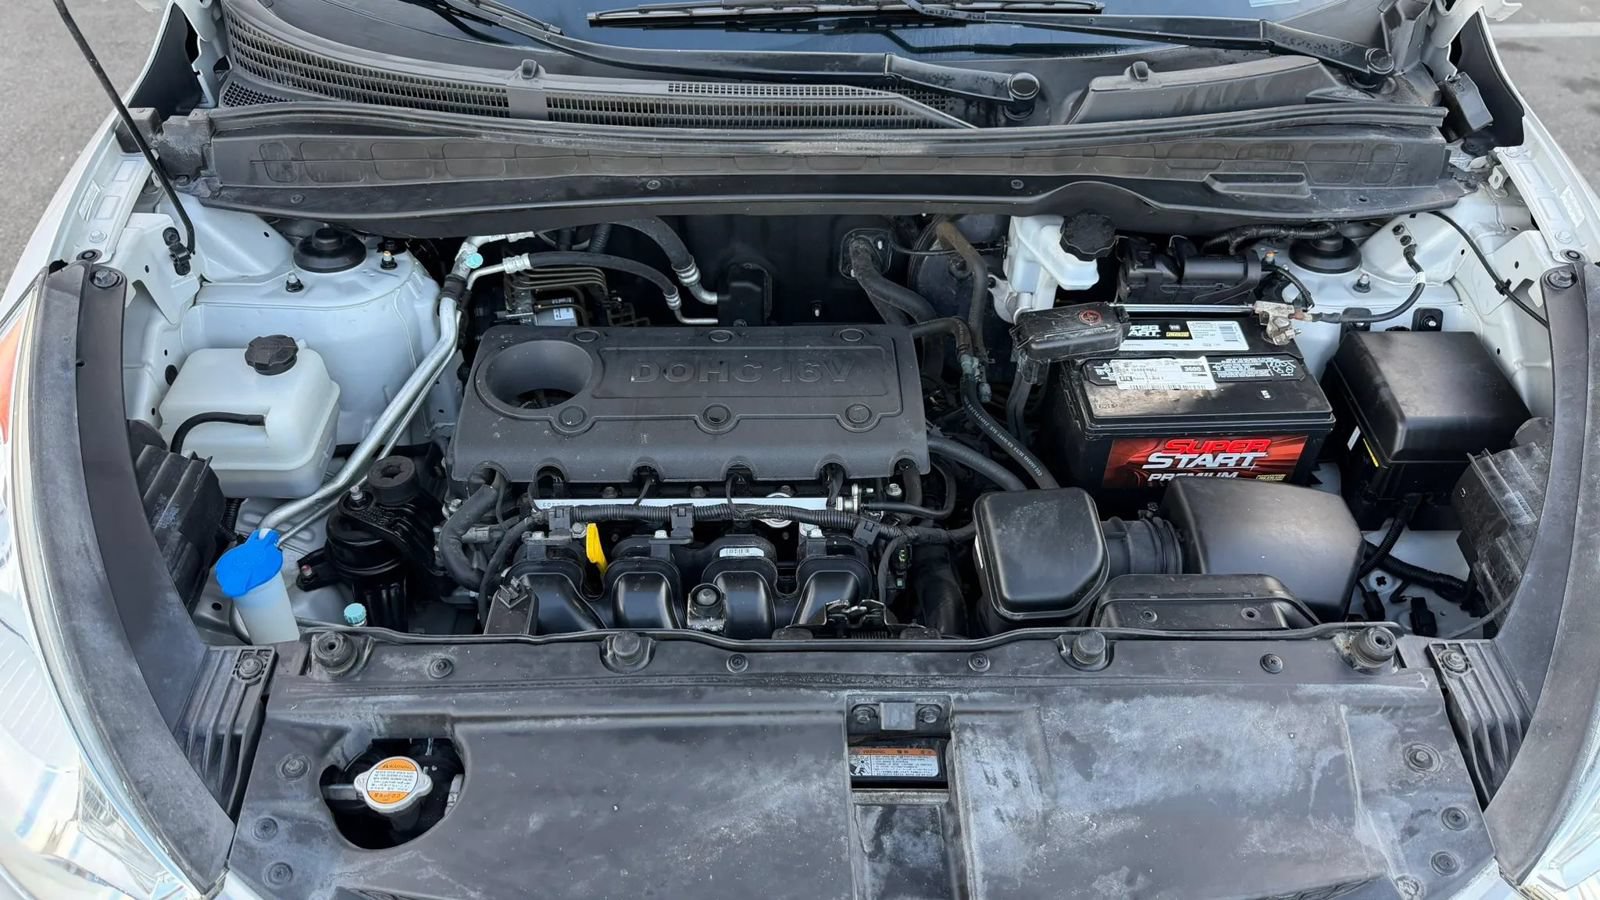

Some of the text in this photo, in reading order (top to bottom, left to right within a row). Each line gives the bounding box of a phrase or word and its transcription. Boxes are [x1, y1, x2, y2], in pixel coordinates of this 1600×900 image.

[631, 360, 856, 383] DOHC 16V
[1162, 439, 1271, 454] SUPER
[1142, 452, 1268, 469] START
